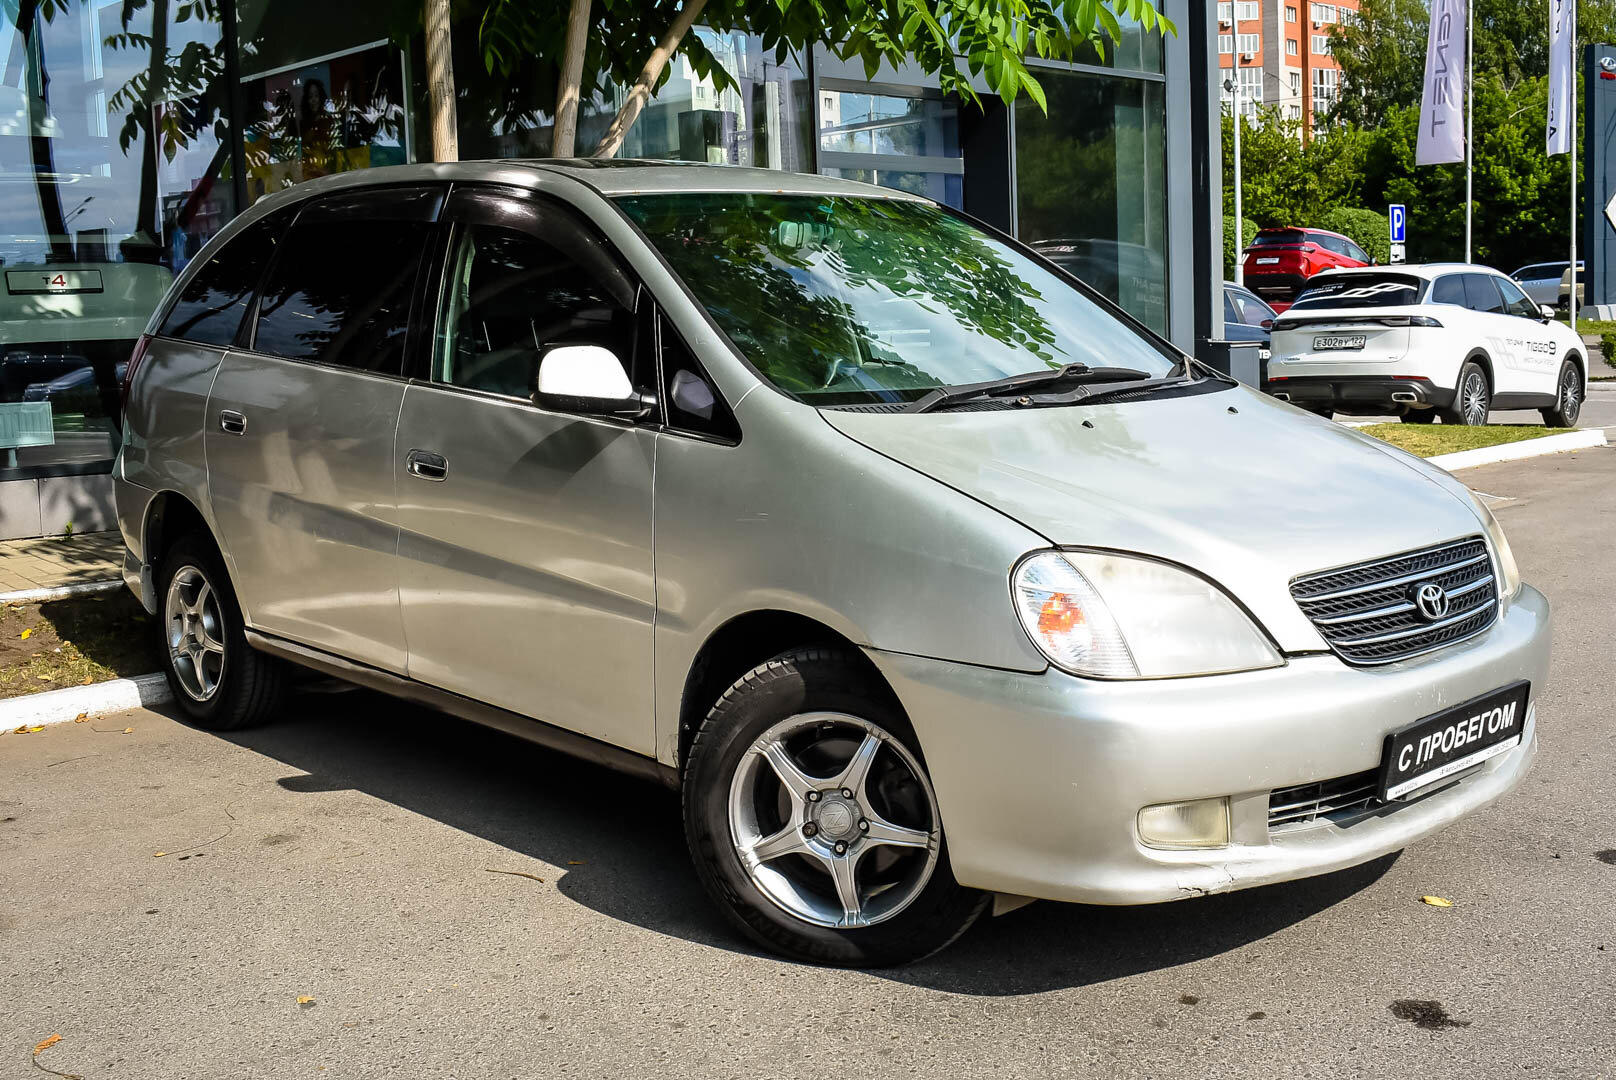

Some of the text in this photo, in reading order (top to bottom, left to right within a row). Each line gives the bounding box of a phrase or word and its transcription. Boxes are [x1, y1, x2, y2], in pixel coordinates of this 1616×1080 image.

[1394, 209, 1402, 239] P
[1398, 701, 1517, 772] С ПРОБЕГОМ
